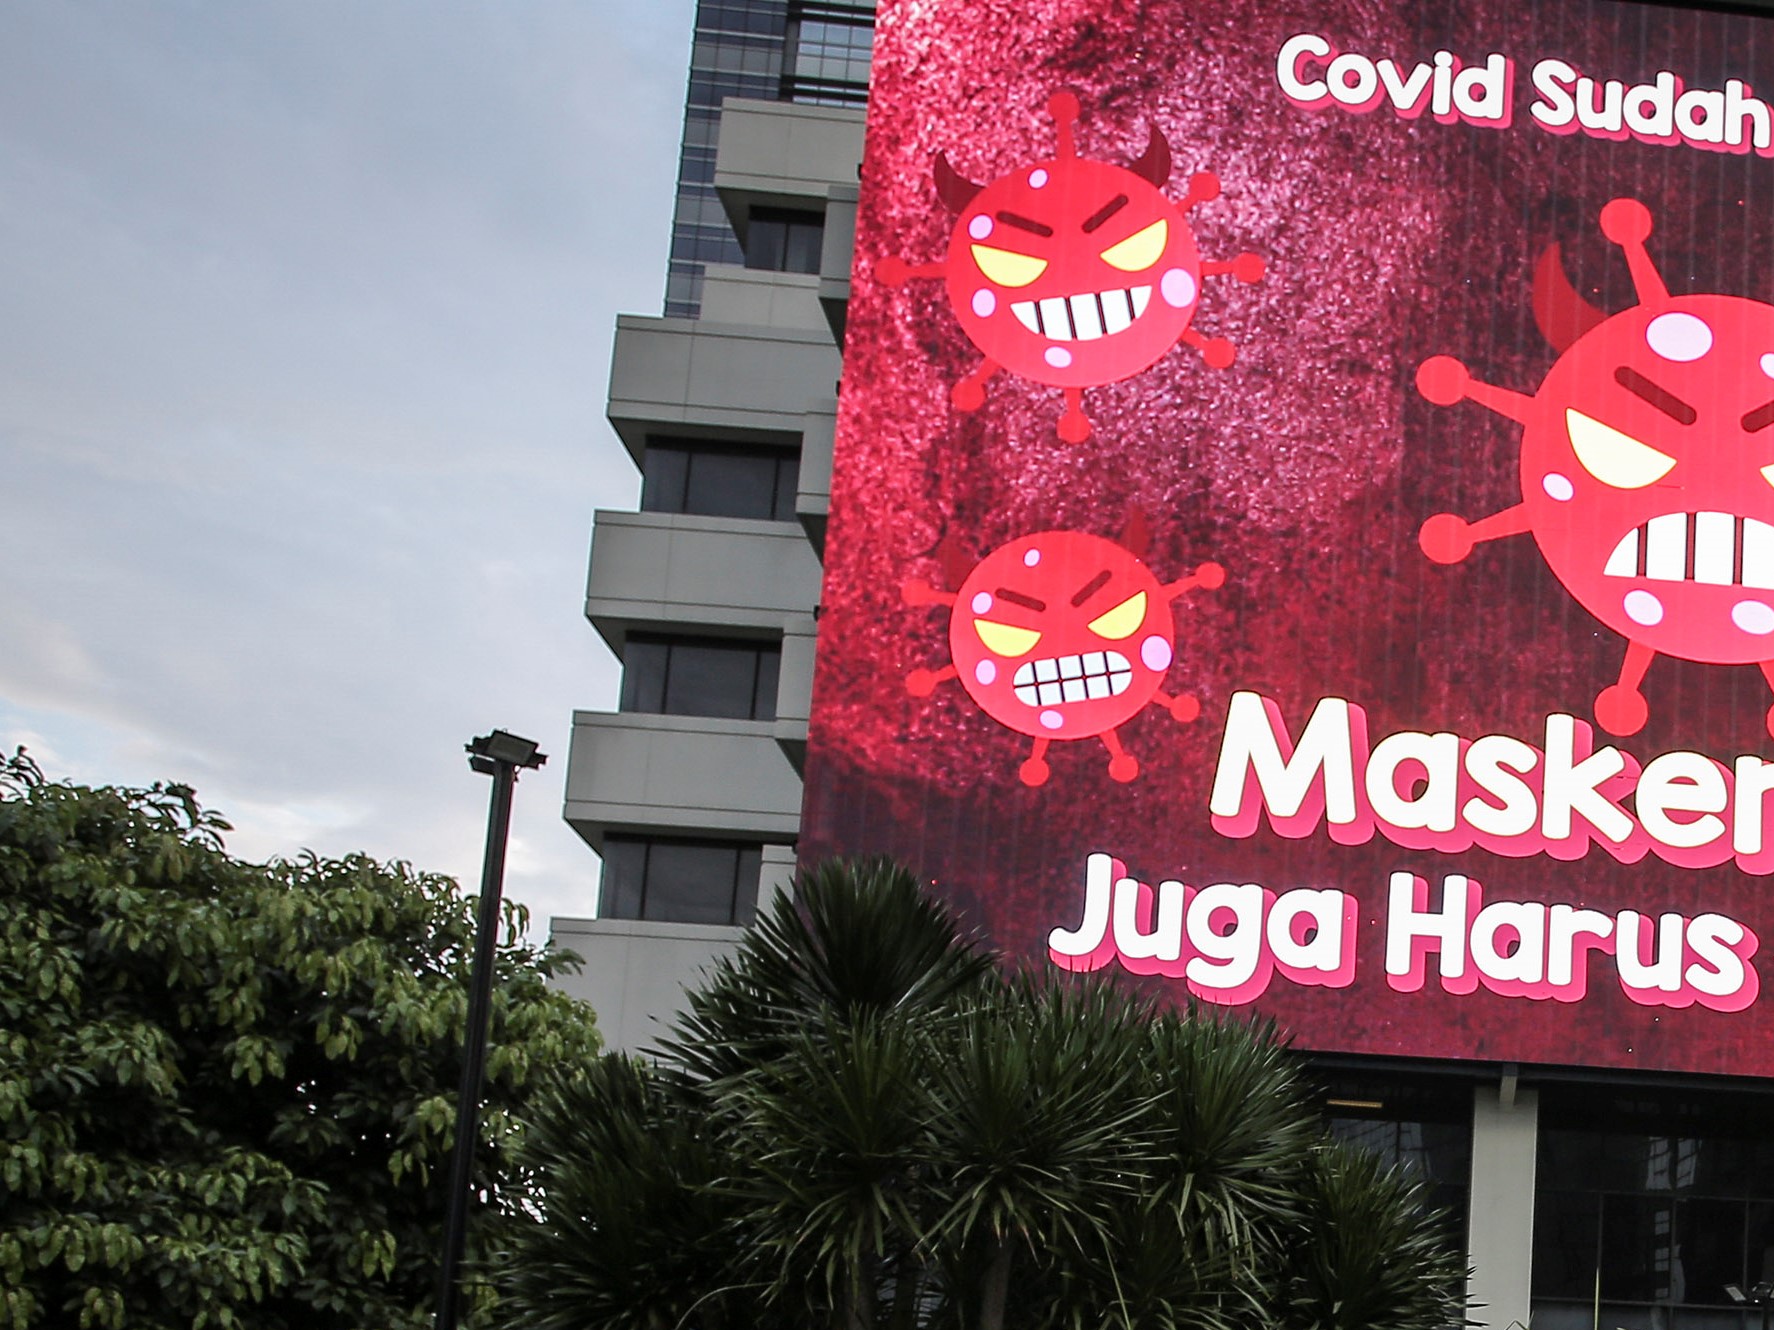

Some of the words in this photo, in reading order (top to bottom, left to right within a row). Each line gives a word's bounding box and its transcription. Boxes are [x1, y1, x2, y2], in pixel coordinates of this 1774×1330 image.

[1276, 33, 1506, 120] Covid
[1530, 59, 1769, 149] Sudah
[1047, 852, 1344, 989] Juga
[1384, 871, 1745, 997] Harus
